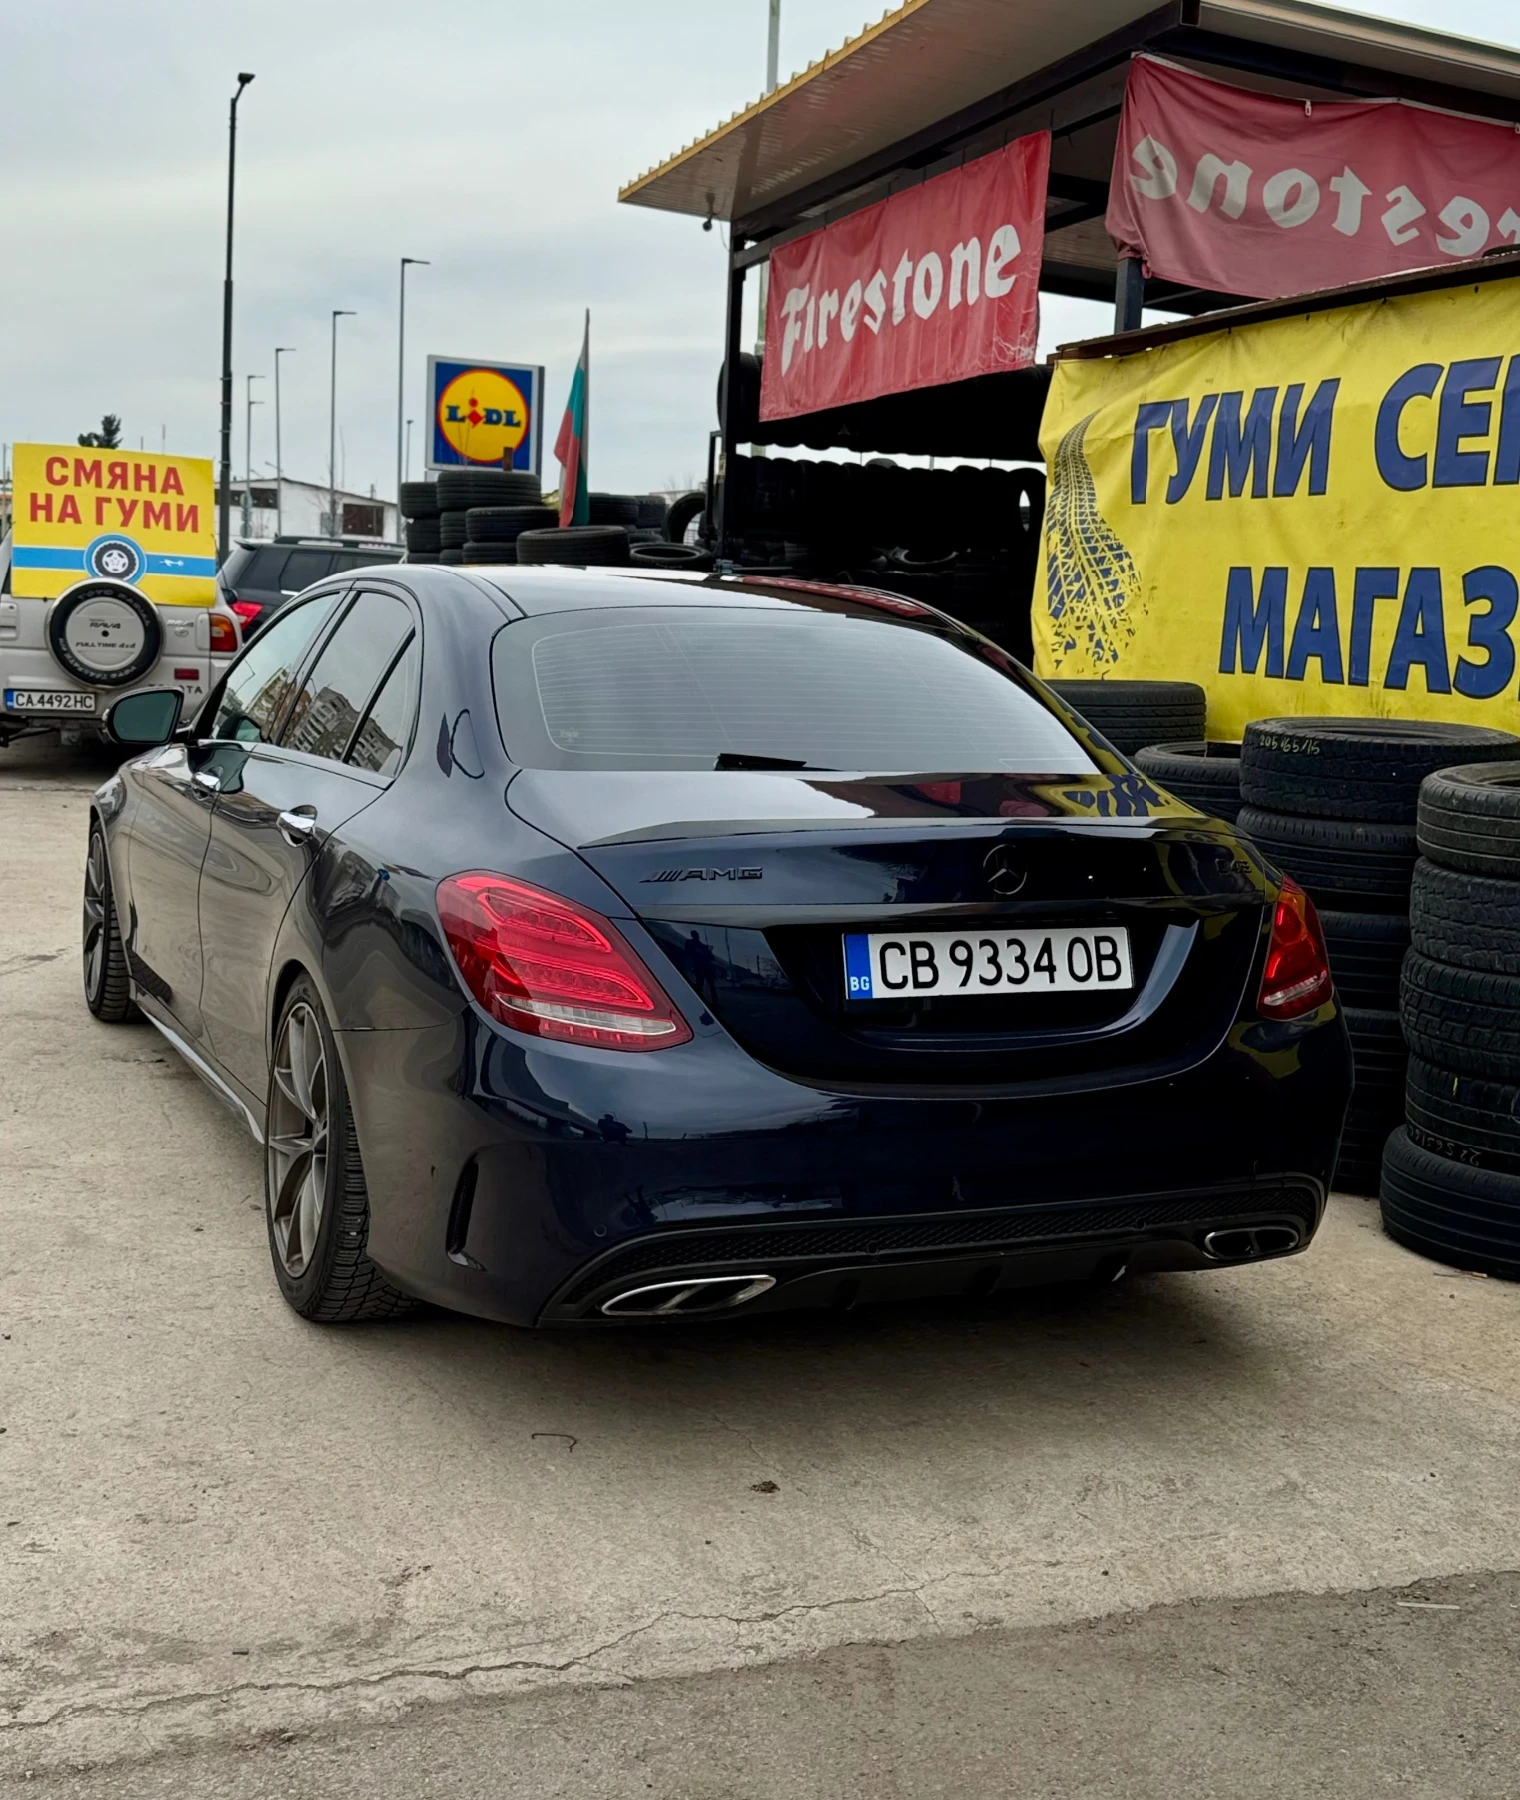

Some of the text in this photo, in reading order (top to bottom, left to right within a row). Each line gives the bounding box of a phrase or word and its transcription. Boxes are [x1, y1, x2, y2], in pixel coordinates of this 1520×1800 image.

[779, 223, 1022, 378] Firestone
[1130, 377, 1341, 505] ГУМИ
[45, 456, 185, 496] СМЯНА
[29, 492, 199, 533] НА ГУМИ
[1217, 565, 1520, 700] МАГАЗ
[15, 693, 34, 707] CA
[37, 694, 73, 708] 4492
[74, 695, 93, 709] HC
[679, 866, 763, 881] AMG
[849, 935, 1122, 992] BG CB 9334 OB
